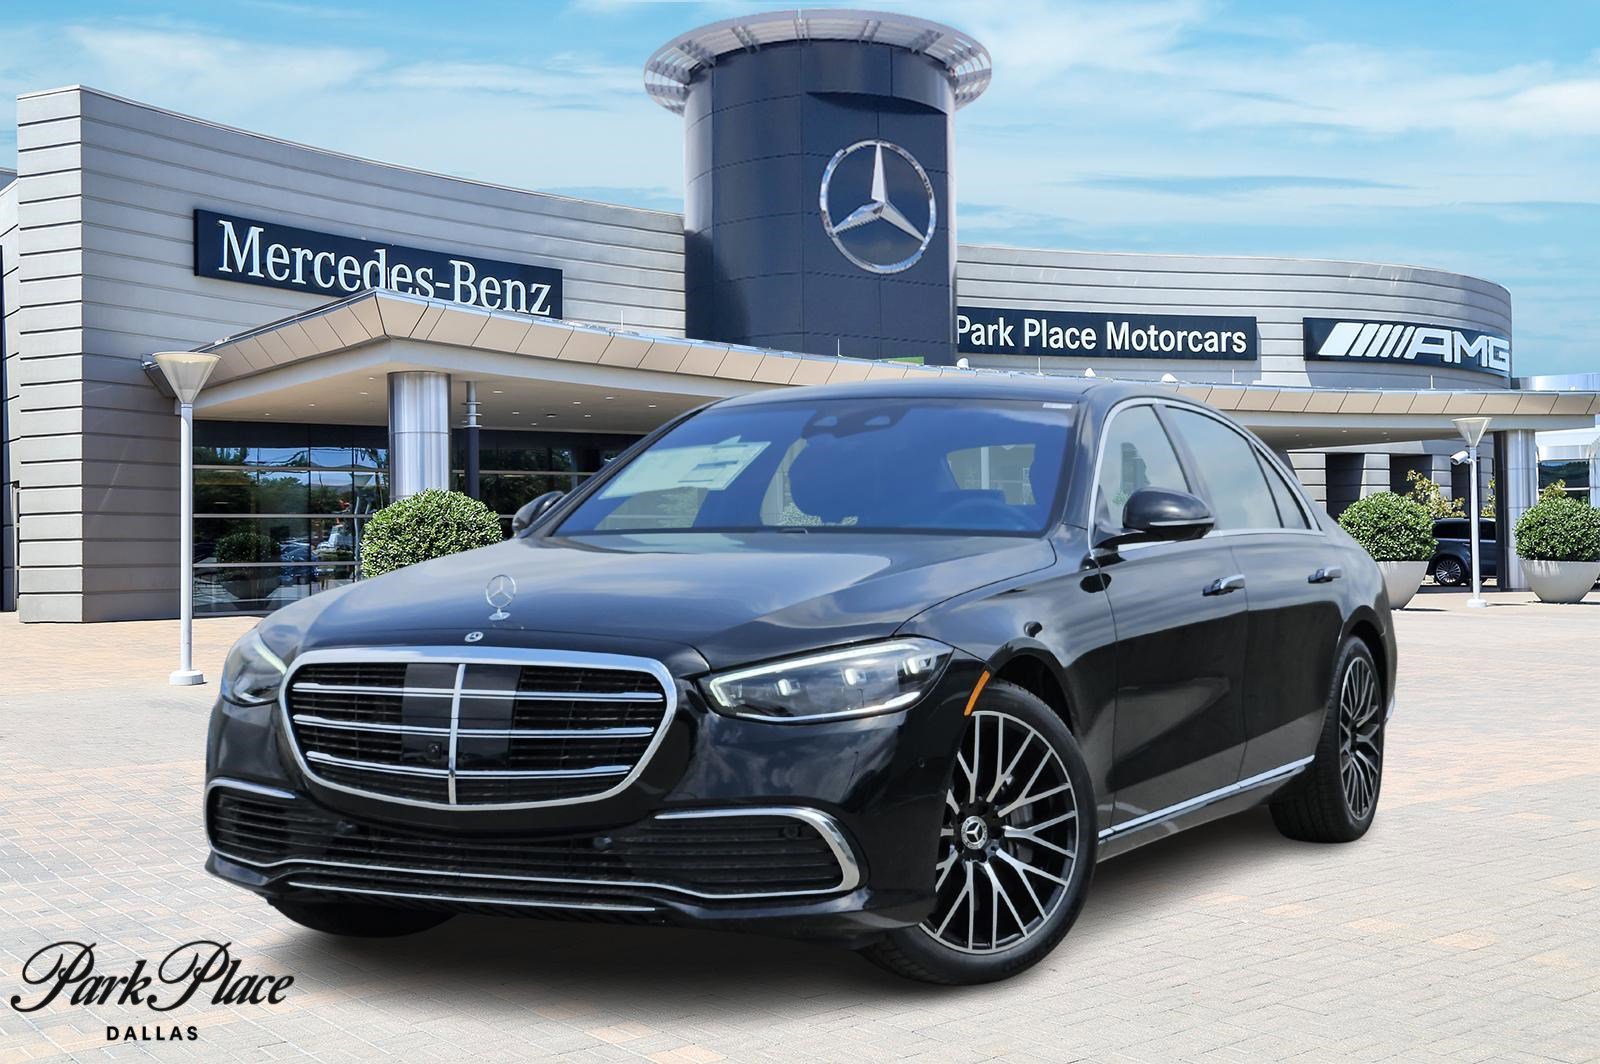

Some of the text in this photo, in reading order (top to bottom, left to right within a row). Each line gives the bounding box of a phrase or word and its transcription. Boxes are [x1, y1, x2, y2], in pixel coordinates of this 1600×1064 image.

[217, 219, 552, 316] Mercedes-Benz
[957, 315, 1248, 354] Park Place Motorcars
